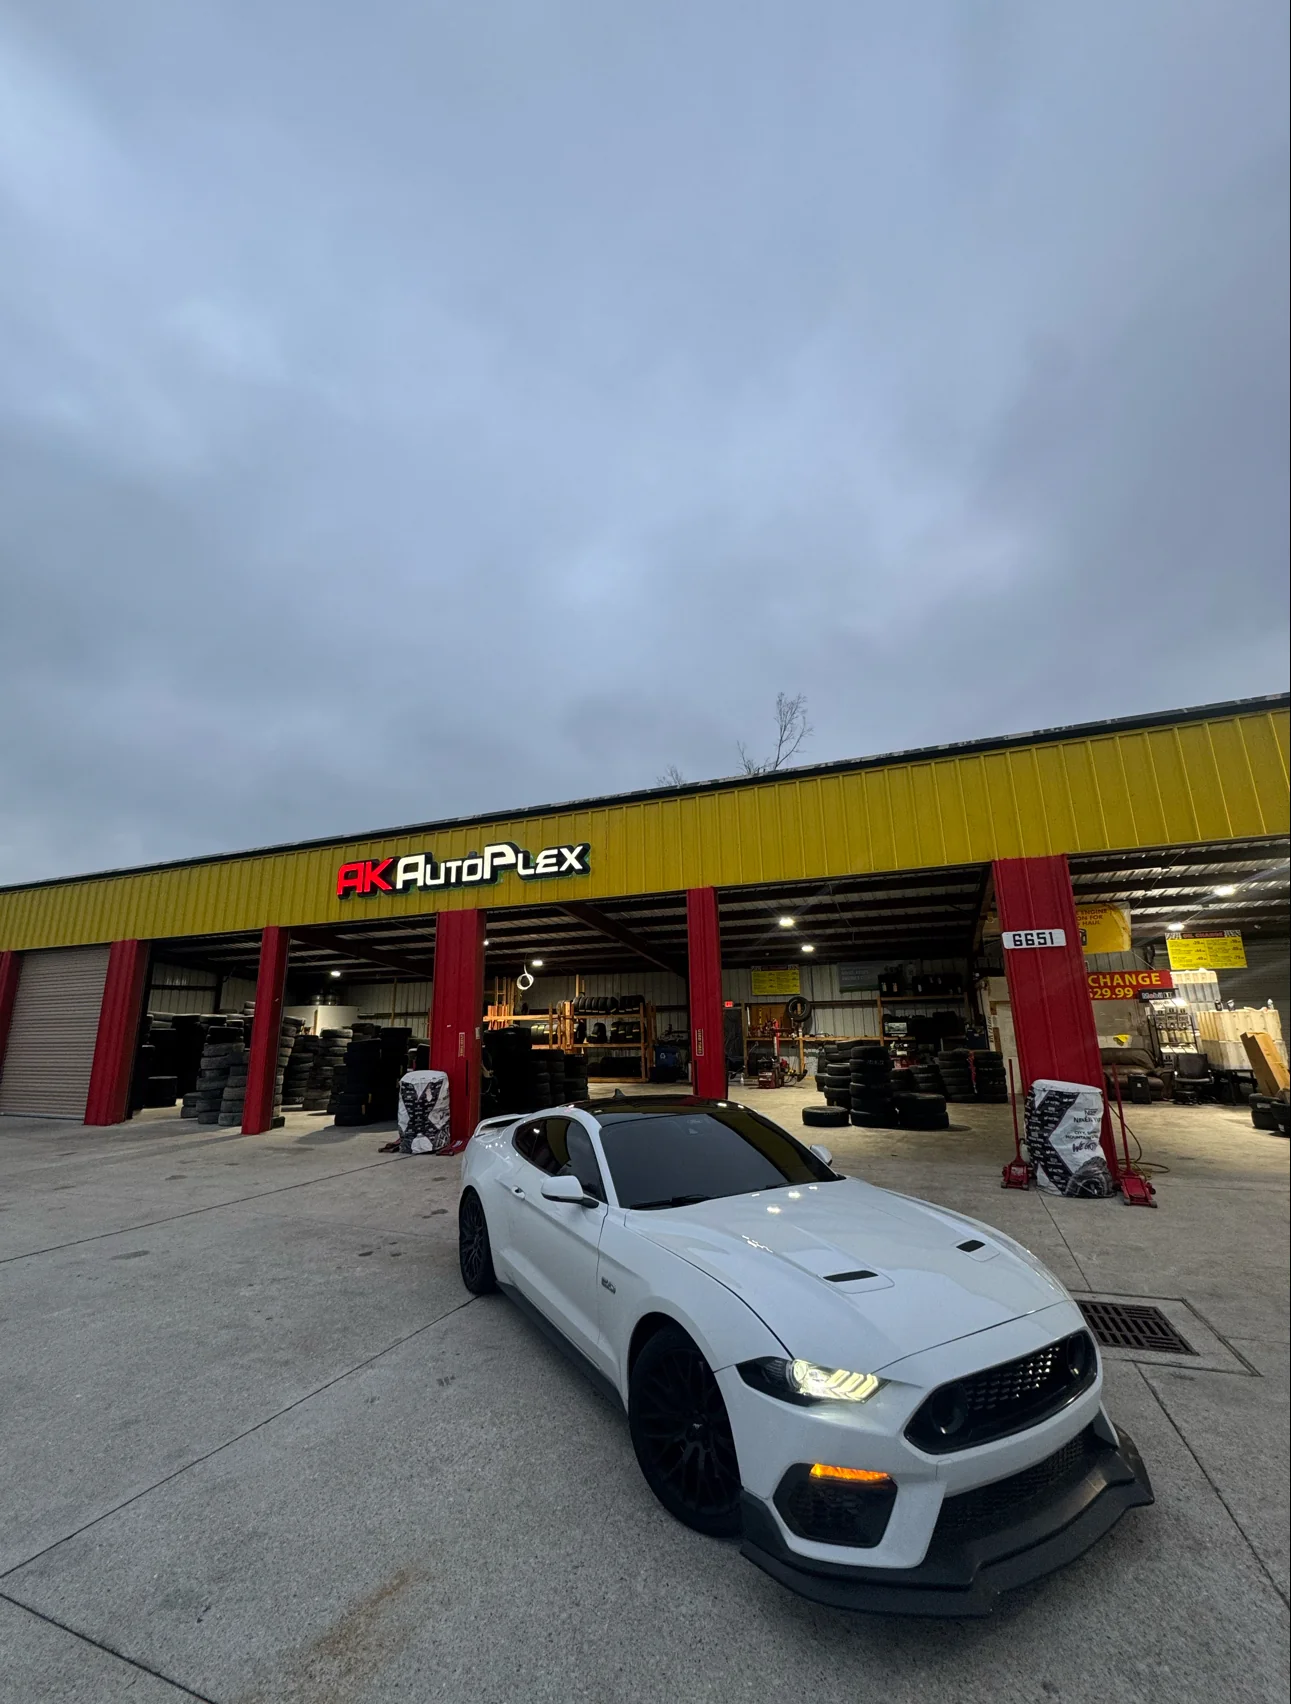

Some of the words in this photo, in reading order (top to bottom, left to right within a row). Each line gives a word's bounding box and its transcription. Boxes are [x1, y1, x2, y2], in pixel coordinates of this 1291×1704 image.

[337, 857, 394, 896] AK
[1012, 931, 1054, 947] 6651
[1088, 972, 1161, 987] CHANGE
